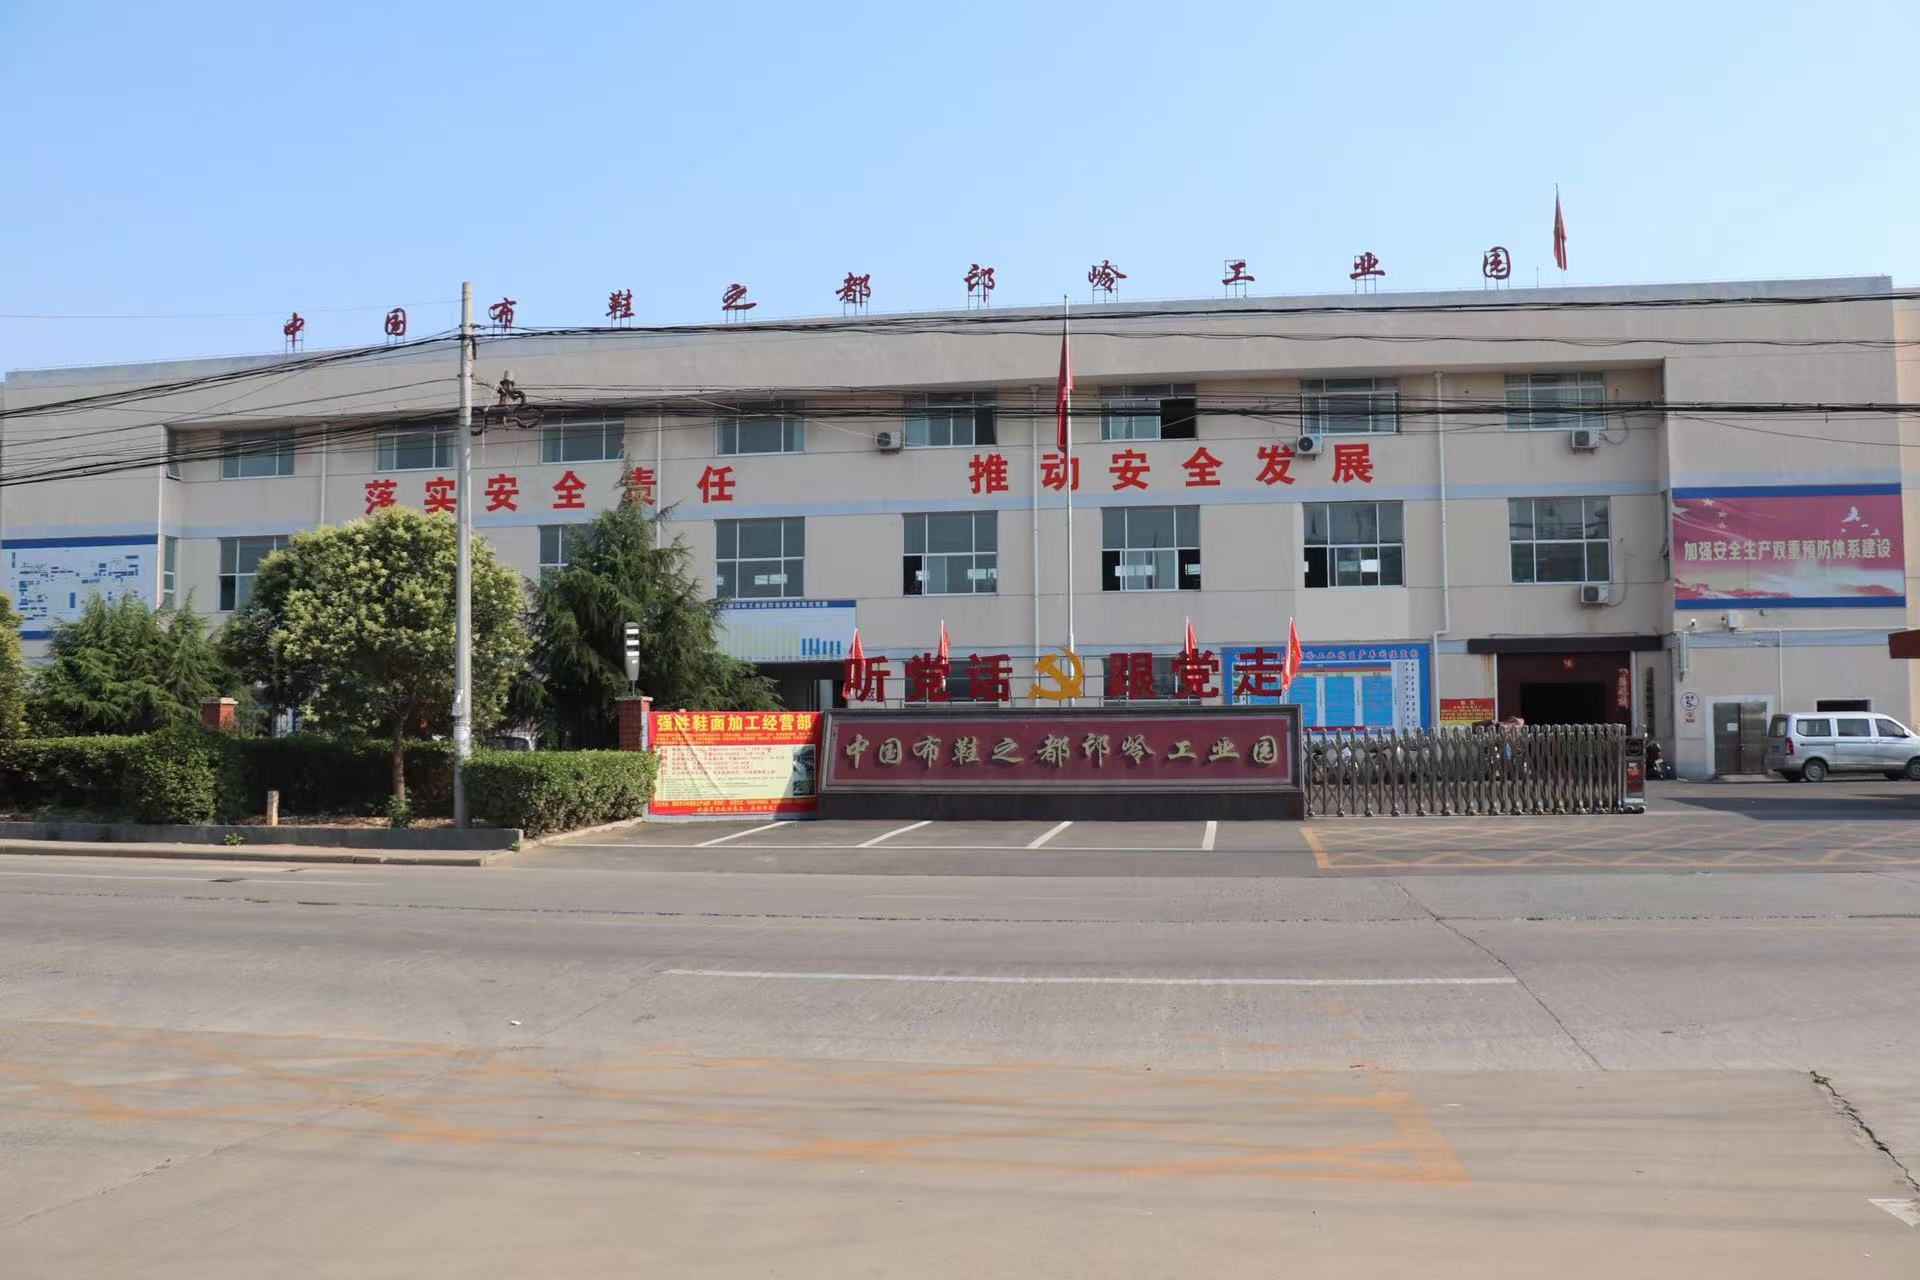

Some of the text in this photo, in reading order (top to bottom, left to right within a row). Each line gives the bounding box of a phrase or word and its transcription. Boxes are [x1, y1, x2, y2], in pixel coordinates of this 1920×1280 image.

[365, 443, 1374, 515] 落实安全责任 推动安全发展
[1684, 537, 1892, 561] 加强安全生产双重预防体系建设
[842, 653, 1013, 702] 听党话
[1109, 646, 1284, 700] 跟党走
[657, 714, 812, 731] 强胜鞋面加工经营部
